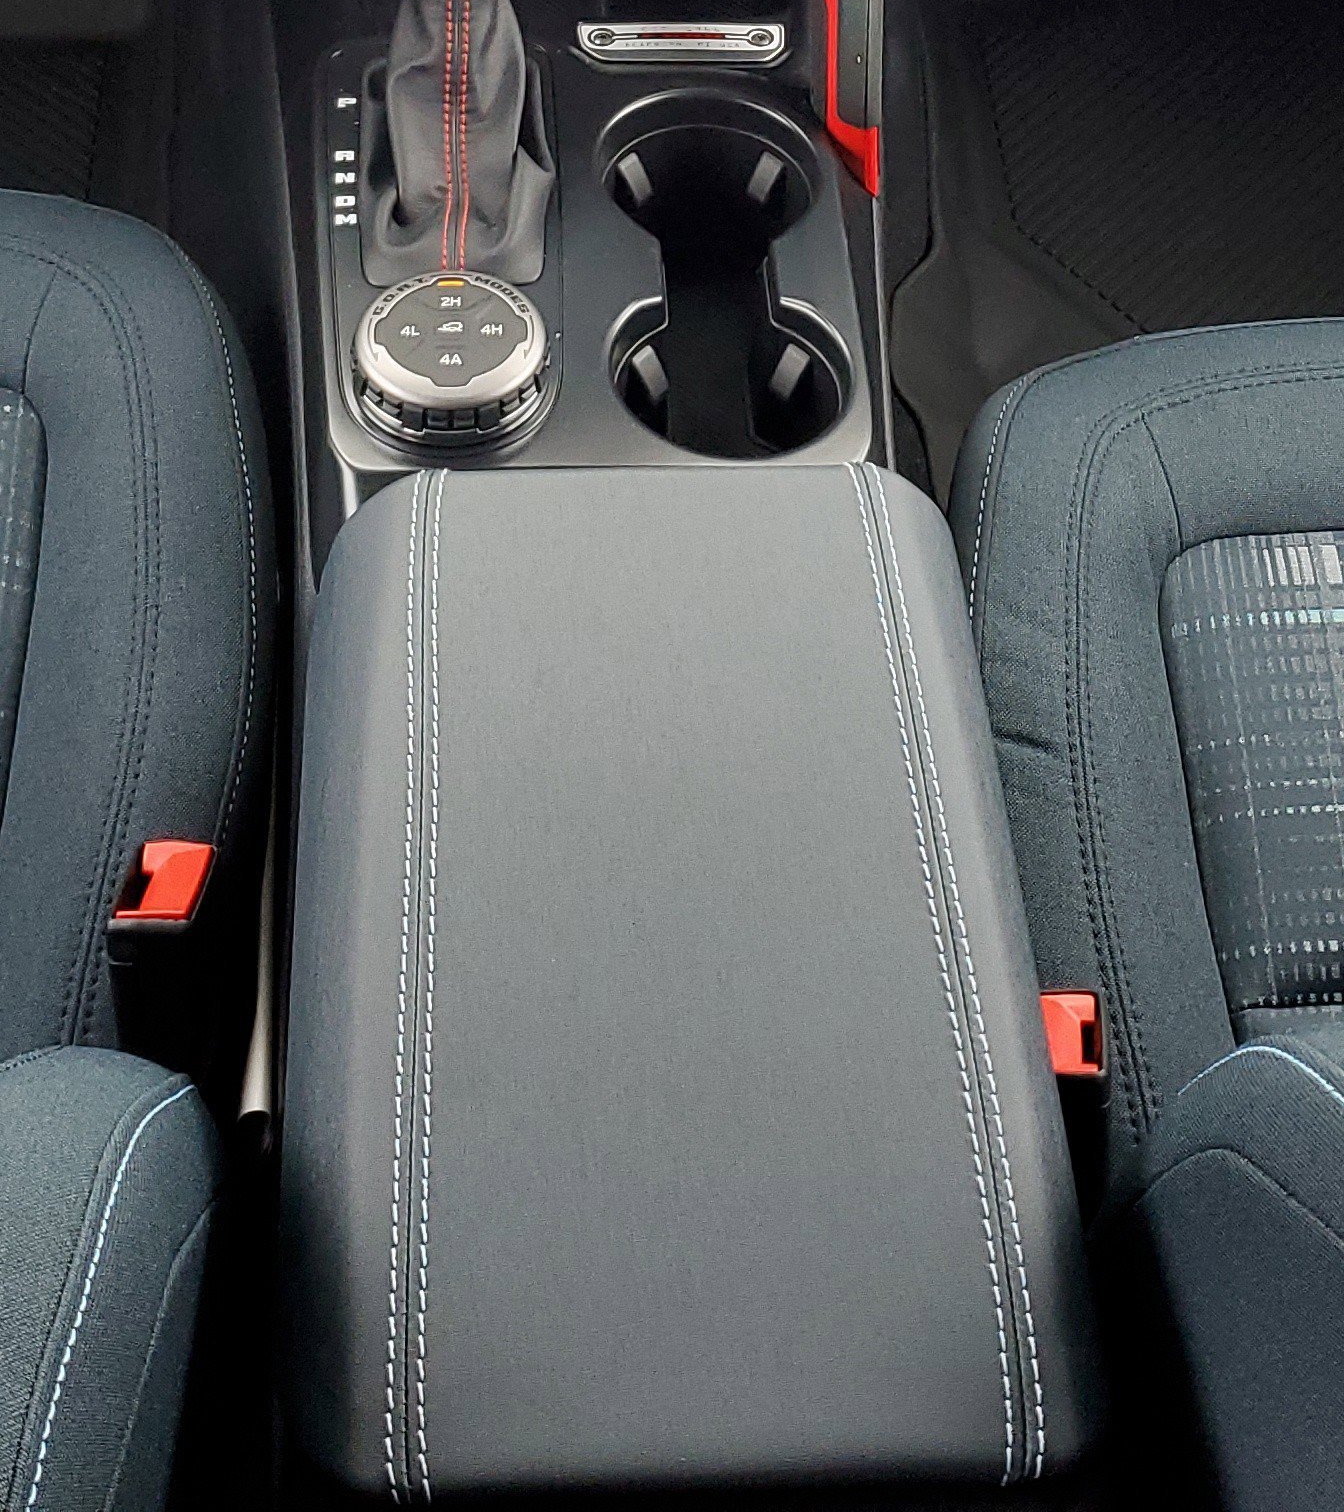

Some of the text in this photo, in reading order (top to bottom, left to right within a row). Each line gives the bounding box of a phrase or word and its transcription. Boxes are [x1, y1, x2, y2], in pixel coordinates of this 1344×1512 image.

[337, 97, 357, 108] P
[335, 172, 356, 184] N
[335, 195, 356, 207] D
[335, 213, 357, 225] M
[475, 275, 530, 314] MODES
[440, 296, 462, 308] 2H
[400, 324, 503, 336] 4L 4H
[439, 353, 463, 366] 4A
